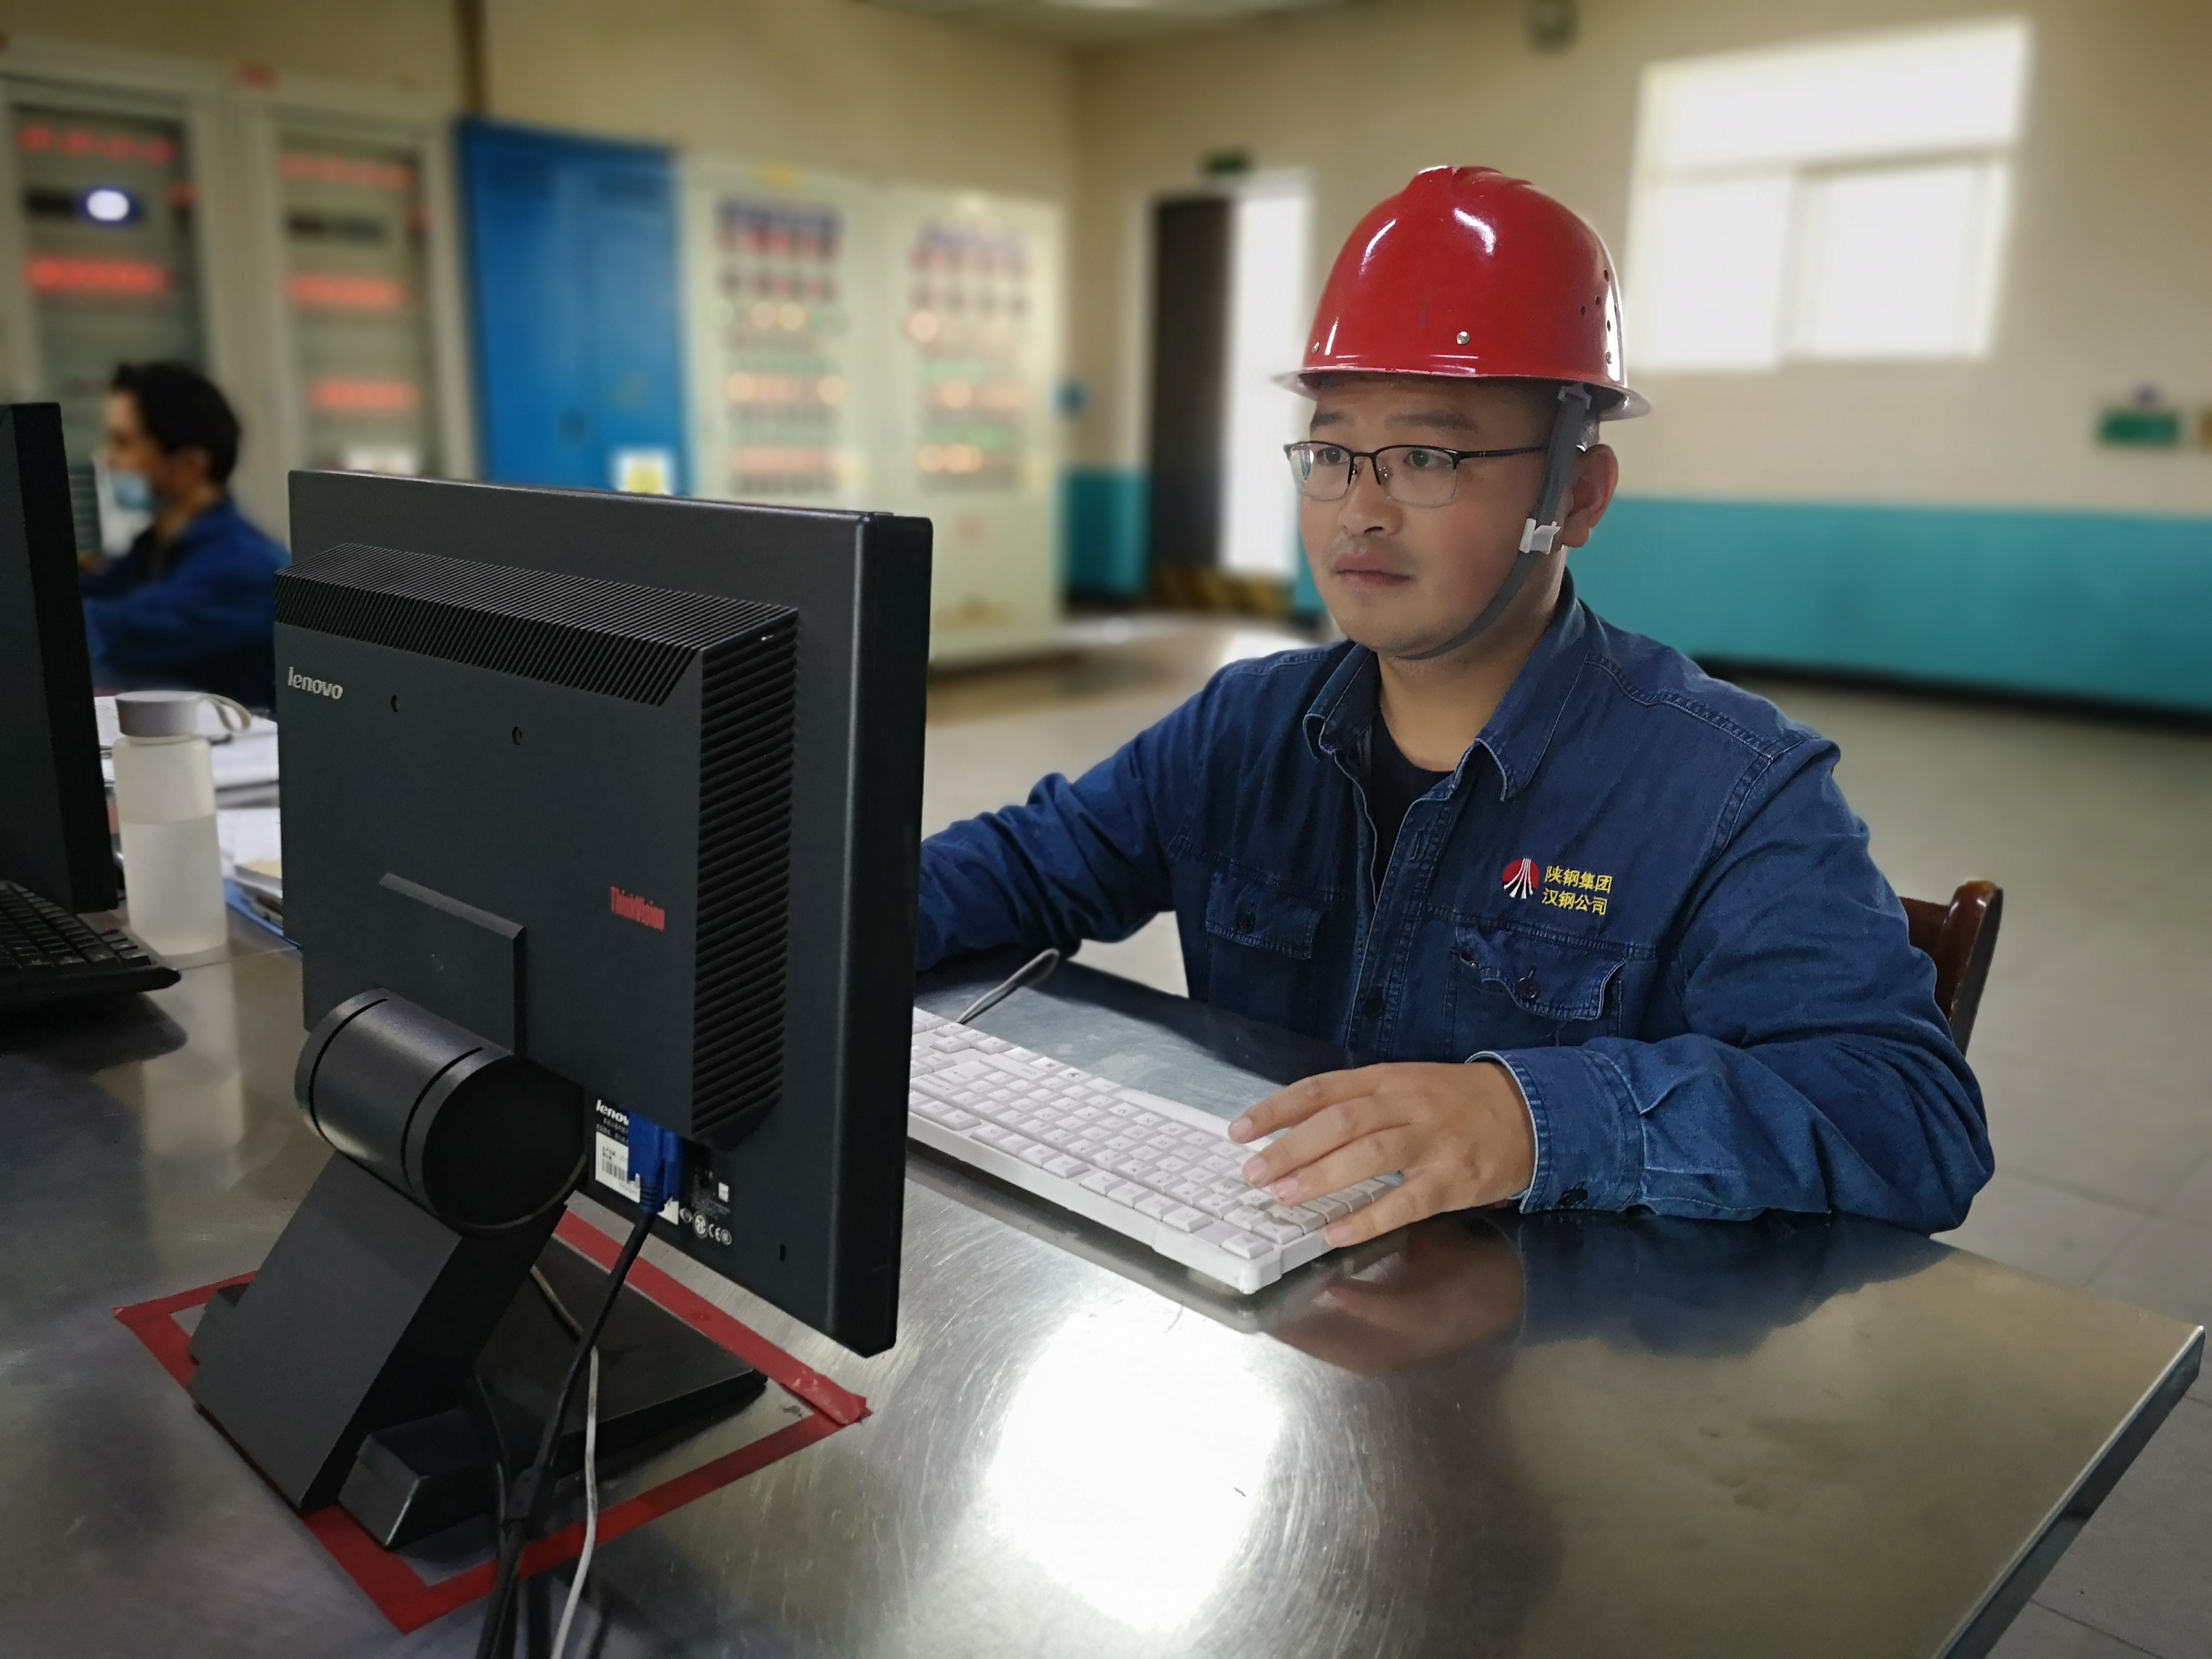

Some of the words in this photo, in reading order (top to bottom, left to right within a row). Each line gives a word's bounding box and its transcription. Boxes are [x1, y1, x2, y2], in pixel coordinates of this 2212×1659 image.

[288, 666, 343, 699] lenovo
[1544, 865, 1613, 894] 陕钢集团
[1541, 887, 1608, 915] 汉钢公司
[596, 1099, 629, 1126] lenov
